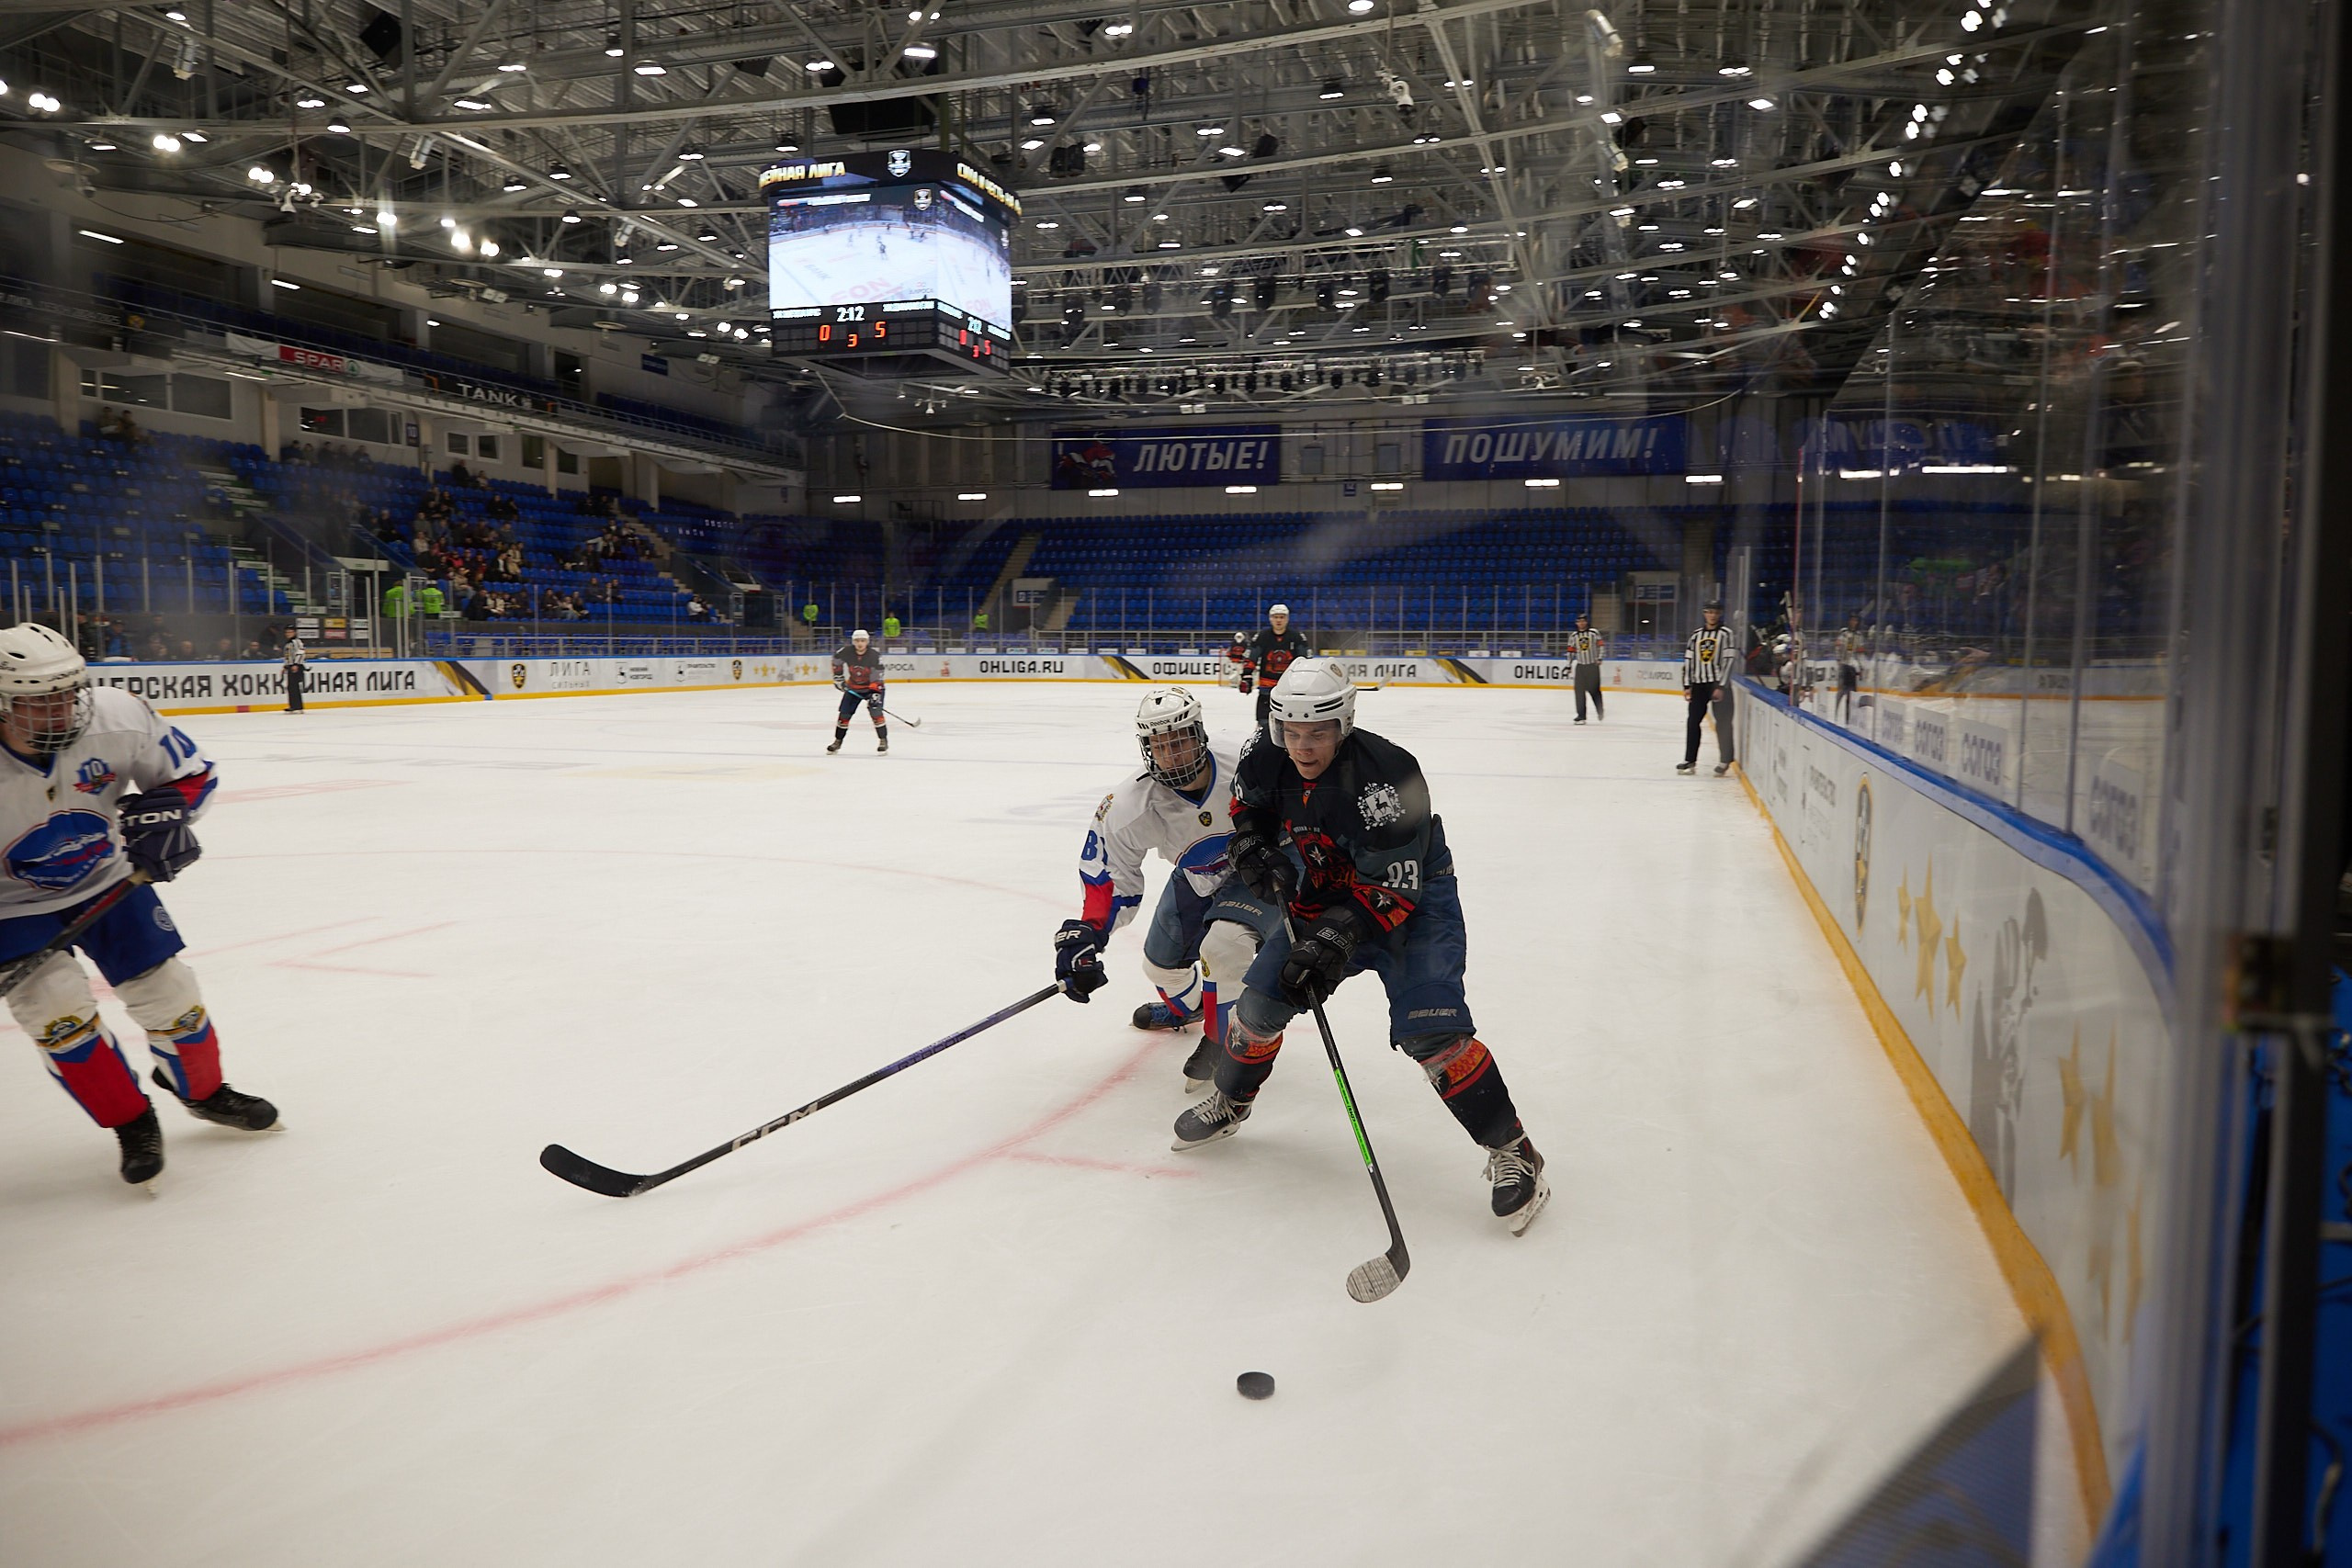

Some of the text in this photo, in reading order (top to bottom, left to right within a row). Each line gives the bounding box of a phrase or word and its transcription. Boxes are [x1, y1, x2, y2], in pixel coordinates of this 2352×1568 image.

[820, 324, 831, 341] 0
[875, 321, 887, 338] 5
[847, 333, 858, 347] 3
[294, 349, 345, 371] SPAR
[457, 382, 517, 408] TANK
[1443, 427, 1658, 464] ПОШУМИМ!
[1133, 441, 1269, 472] ЛЮТЫЕ!
[549, 661, 591, 677] ЛИГА
[979, 660, 1063, 674] OHLIGA.RU
[1374, 664, 1416, 678] ЛИГА
[367, 670, 415, 692] ЛИГА
[1149, 717, 1171, 728] Reebok
[85, 760, 104, 777] 10
[1382, 860, 1419, 890] 93
[1217, 900, 1263, 917] BAUER
[1408, 1008, 1458, 1020] BAUER
